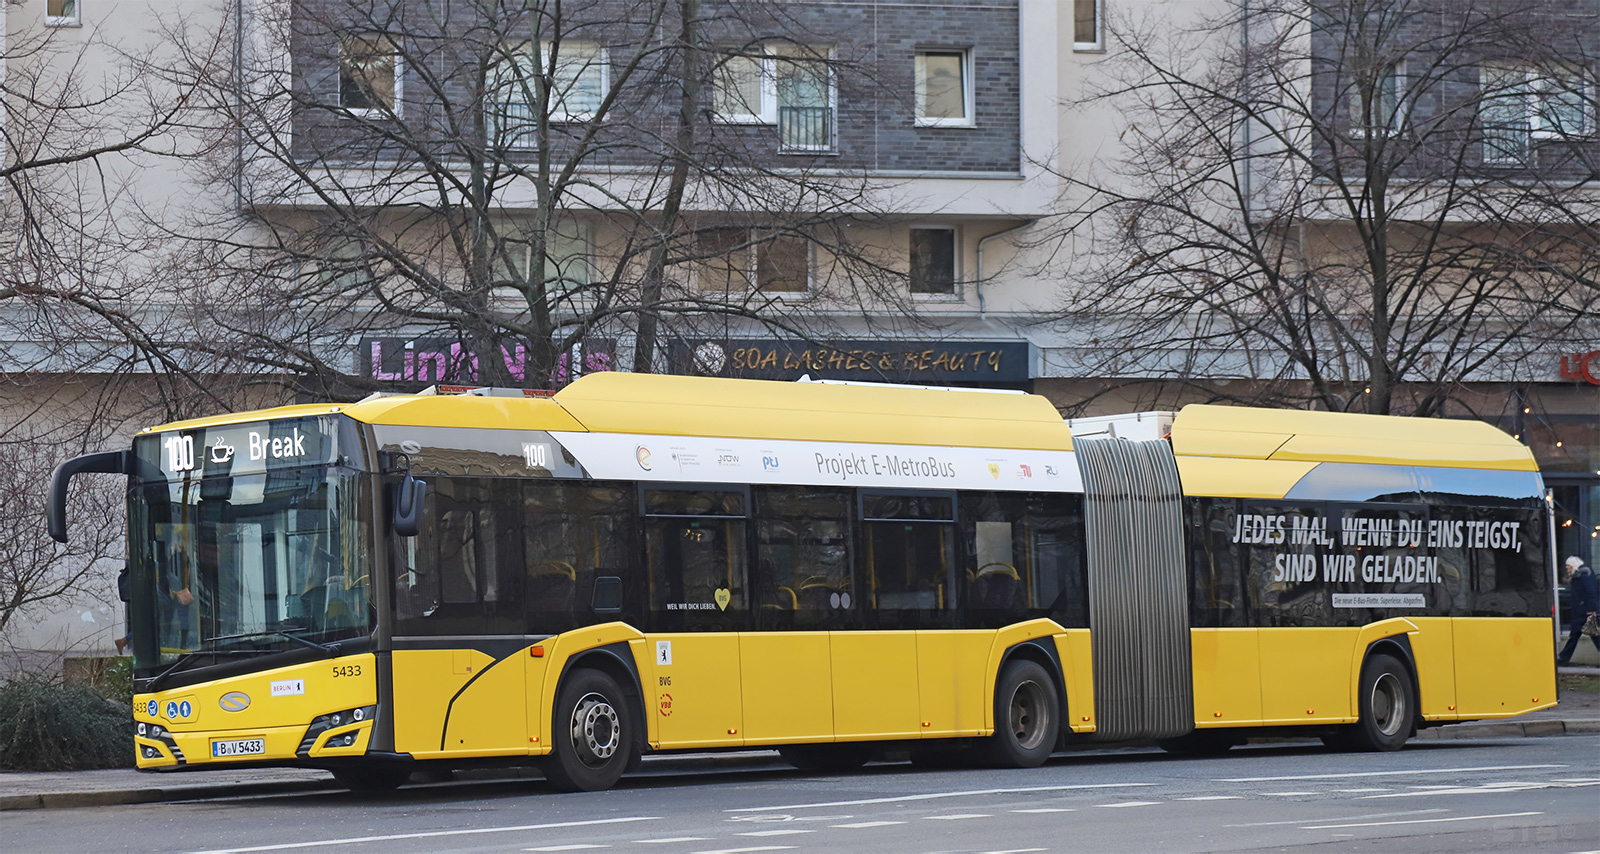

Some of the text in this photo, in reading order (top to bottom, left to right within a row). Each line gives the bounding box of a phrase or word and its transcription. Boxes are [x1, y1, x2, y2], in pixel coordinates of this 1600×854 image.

[371, 341, 612, 382] Linh Nils
[733, 347, 1003, 372] SOA LASHES & BEAUTY
[165, 435, 195, 472] 100
[249, 427, 305, 461] Break
[523, 445, 546, 467] 100
[815, 452, 956, 481] Projekt E-MetroBus
[1232, 514, 1286, 544] JEDES
[1291, 515, 1334, 550] MAL,
[1341, 517, 1393, 547] WENN
[1397, 519, 1422, 548] DU
[1274, 553, 1442, 584] SIND WIR GELADEN.
[332, 665, 362, 678] 5433
[659, 676, 672, 687] BVG
[273, 684, 292, 692] BERLIN
[133, 702, 148, 714] 5433
[660, 701, 672, 709] VBB
[220, 743, 227, 755] B
[238, 740, 261, 753] 5433
